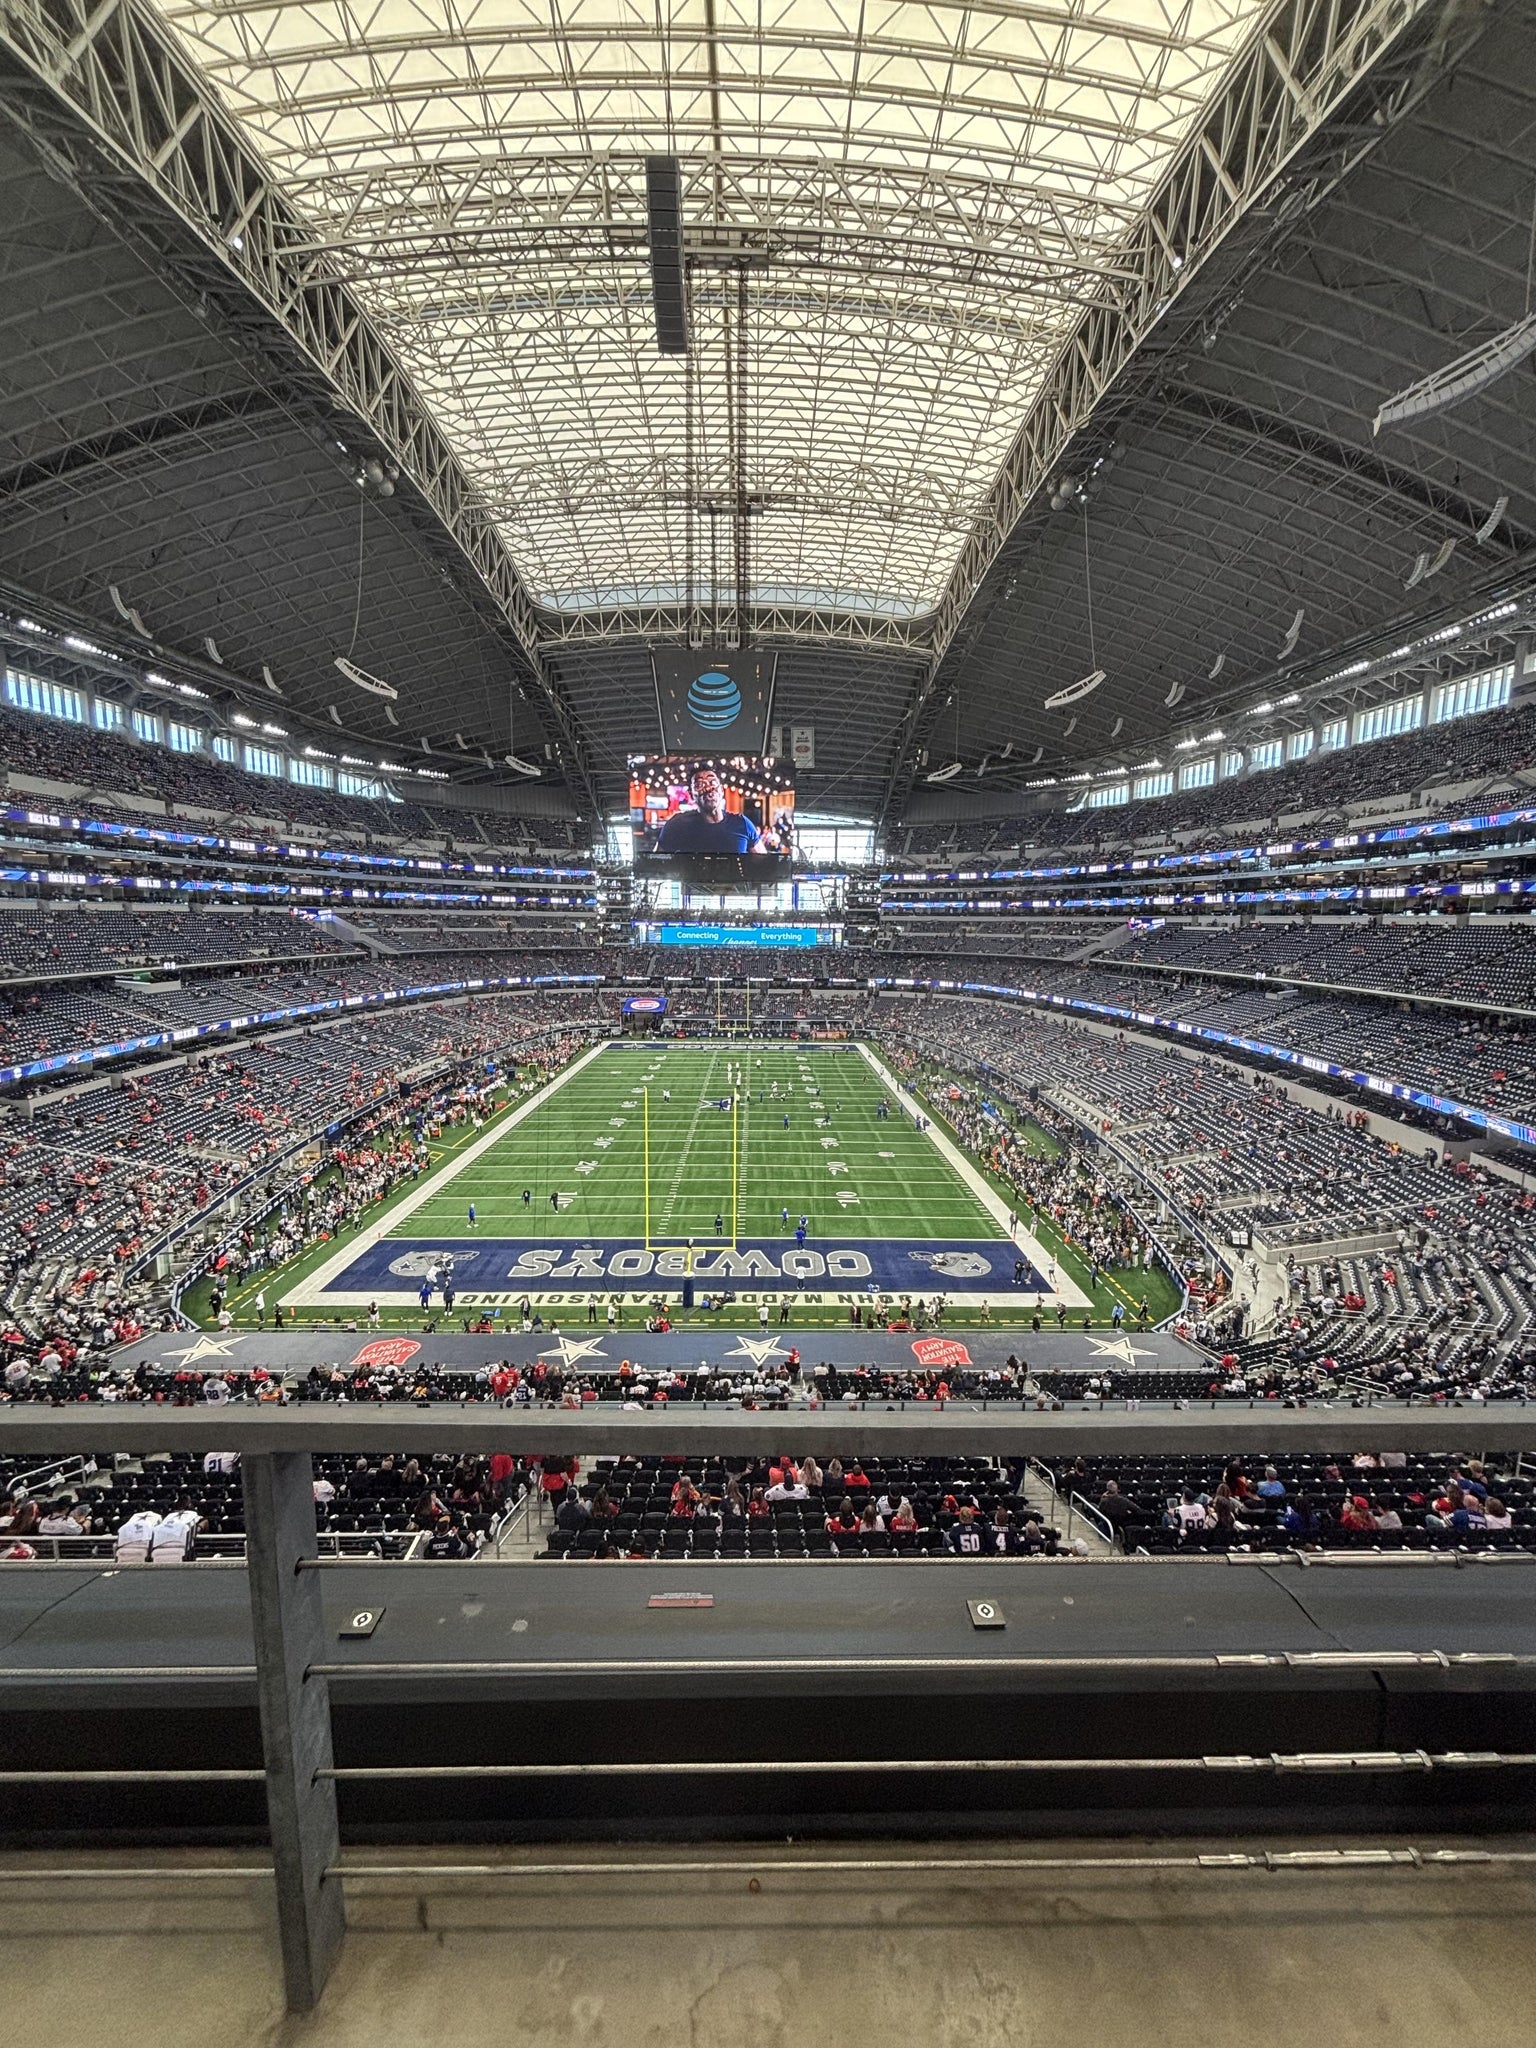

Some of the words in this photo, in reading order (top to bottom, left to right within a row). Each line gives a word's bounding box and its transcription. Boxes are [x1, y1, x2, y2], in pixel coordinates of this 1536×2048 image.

[676, 931, 719, 941] Connecting
[760, 932, 802, 941] Everything
[835, 1191, 860, 1204] 10
[507, 1250, 873, 1277] COWBOYS
[702, 1294, 823, 1304] MADDN
[921, 1341, 945, 1354] ARMY
[922, 1344, 964, 1362] SALVATION
[941, 1353, 961, 1363] THE
[208, 1458, 223, 1473] 21
[960, 1534, 980, 1552] 50
[995, 1533, 1007, 1551] 4
